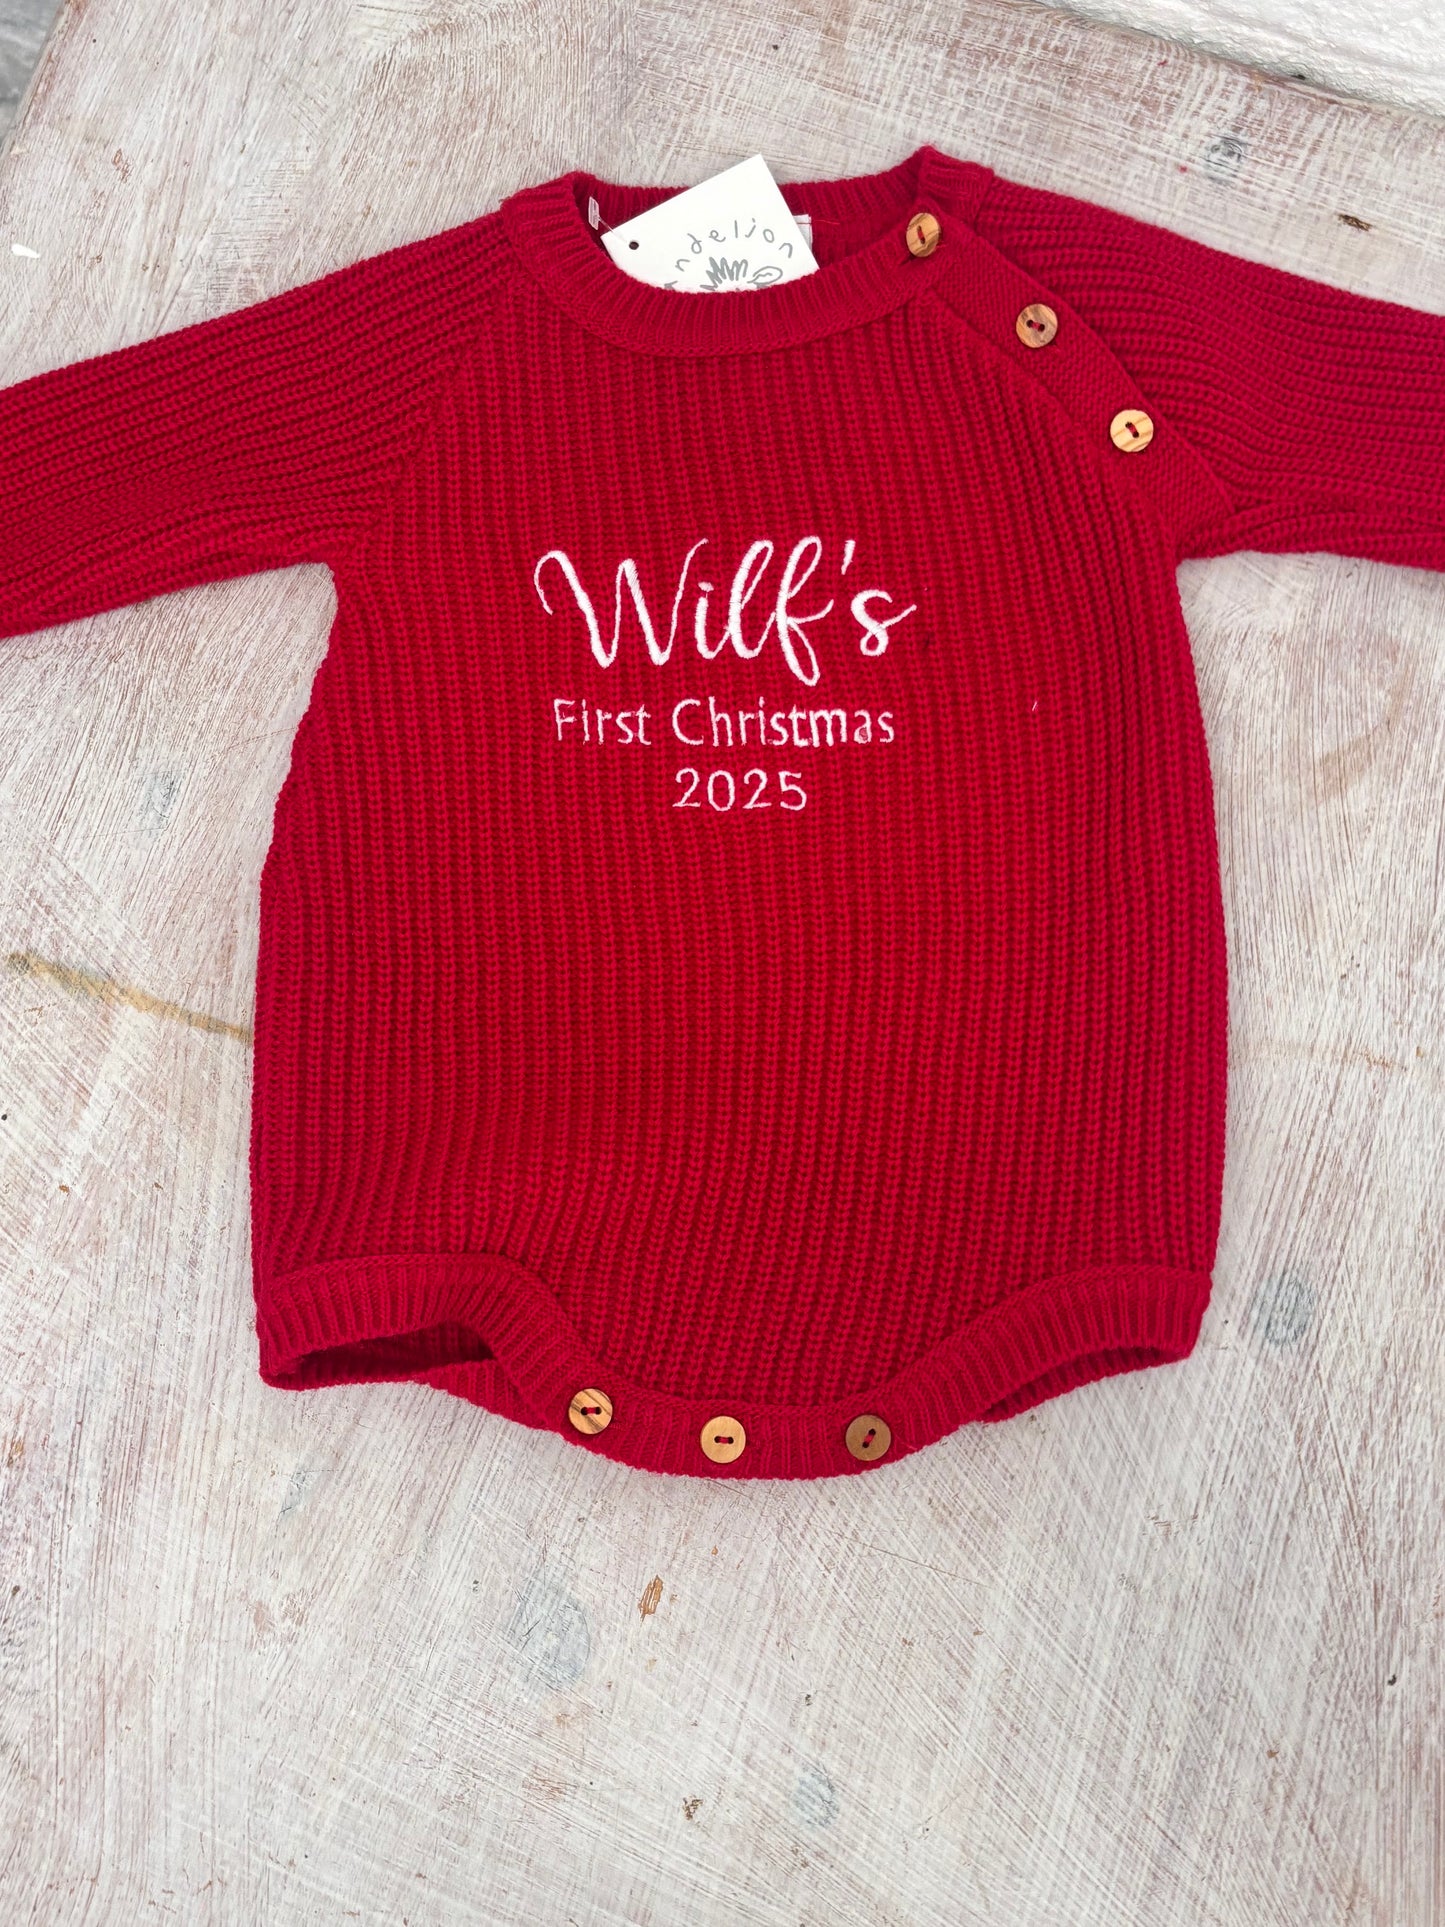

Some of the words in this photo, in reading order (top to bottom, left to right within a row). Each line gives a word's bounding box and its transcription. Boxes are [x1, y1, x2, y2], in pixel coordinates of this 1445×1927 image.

[534, 536, 917, 686] Wilf's
[553, 699, 652, 746] First
[672, 696, 895, 747] Christmas
[673, 768, 807, 811] 2025
